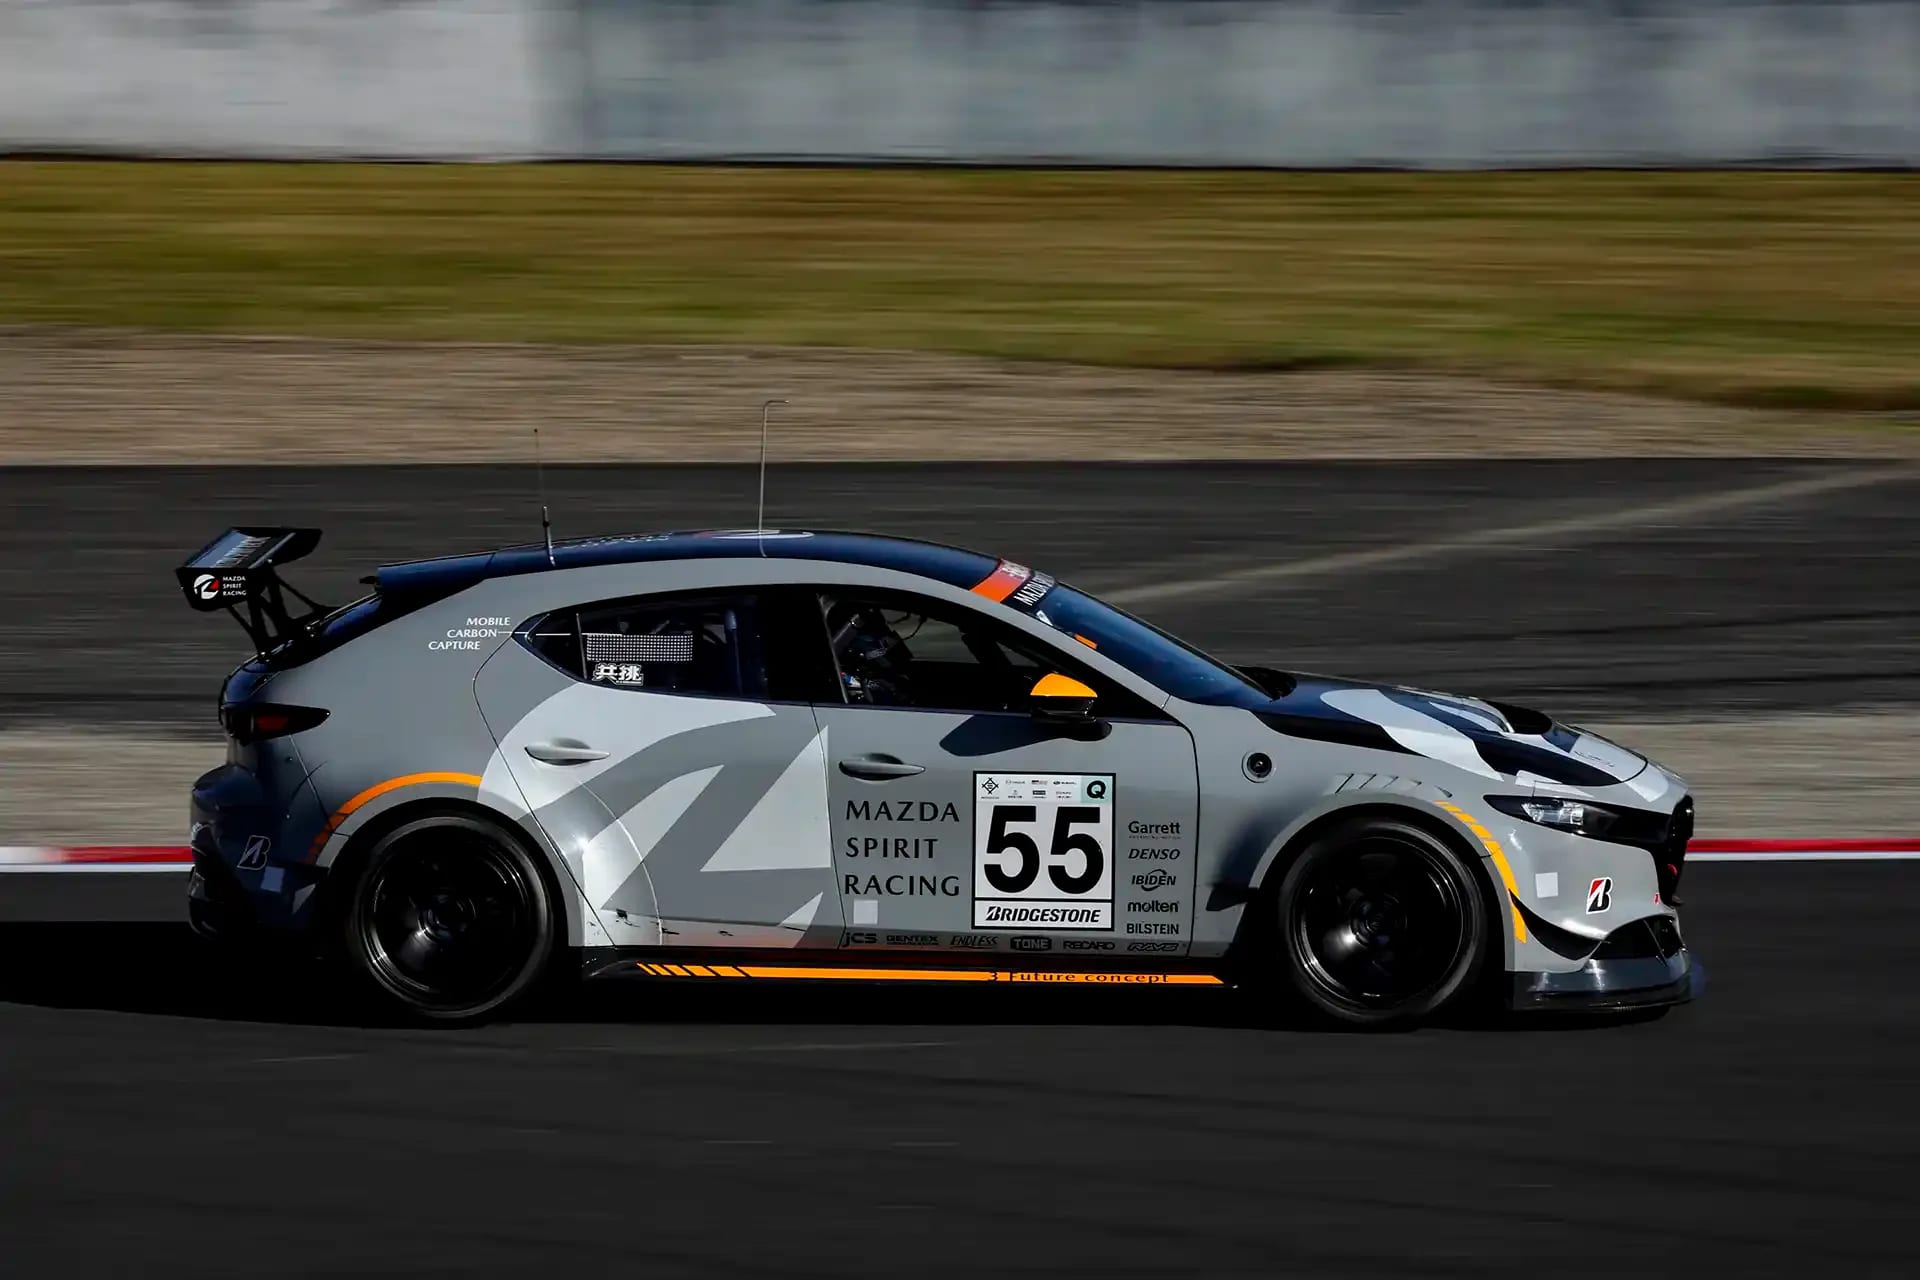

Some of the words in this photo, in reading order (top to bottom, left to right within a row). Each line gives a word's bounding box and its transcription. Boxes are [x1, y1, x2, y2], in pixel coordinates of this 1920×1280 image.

[466, 617, 511, 626] MOBILE
[446, 628, 497, 638] CARBON
[428, 641, 481, 650] CAPTURE
[1086, 780, 1107, 799] Q
[846, 800, 960, 822] MAZDA
[1128, 820, 1181, 834] Garrett
[845, 837, 938, 858] SPIRIT
[984, 805, 1104, 894] 55
[1128, 848, 1181, 860] DENSO
[844, 874, 960, 896] RACING
[1131, 873, 1177, 888] IBIDEN
[1127, 900, 1179, 913] molten
[985, 906, 1101, 923] BRIDGESTONE
[1126, 923, 1180, 935] BILSTEIN
[886, 934, 939, 942] GENTEX
[951, 935, 999, 946] ENDLESS
[1013, 938, 1049, 949] TONE
[1063, 940, 1116, 950] RECARO
[1127, 942, 1179, 951] RAYS
[1009, 971, 1076, 983] Future
[1085, 973, 1169, 984] concept
